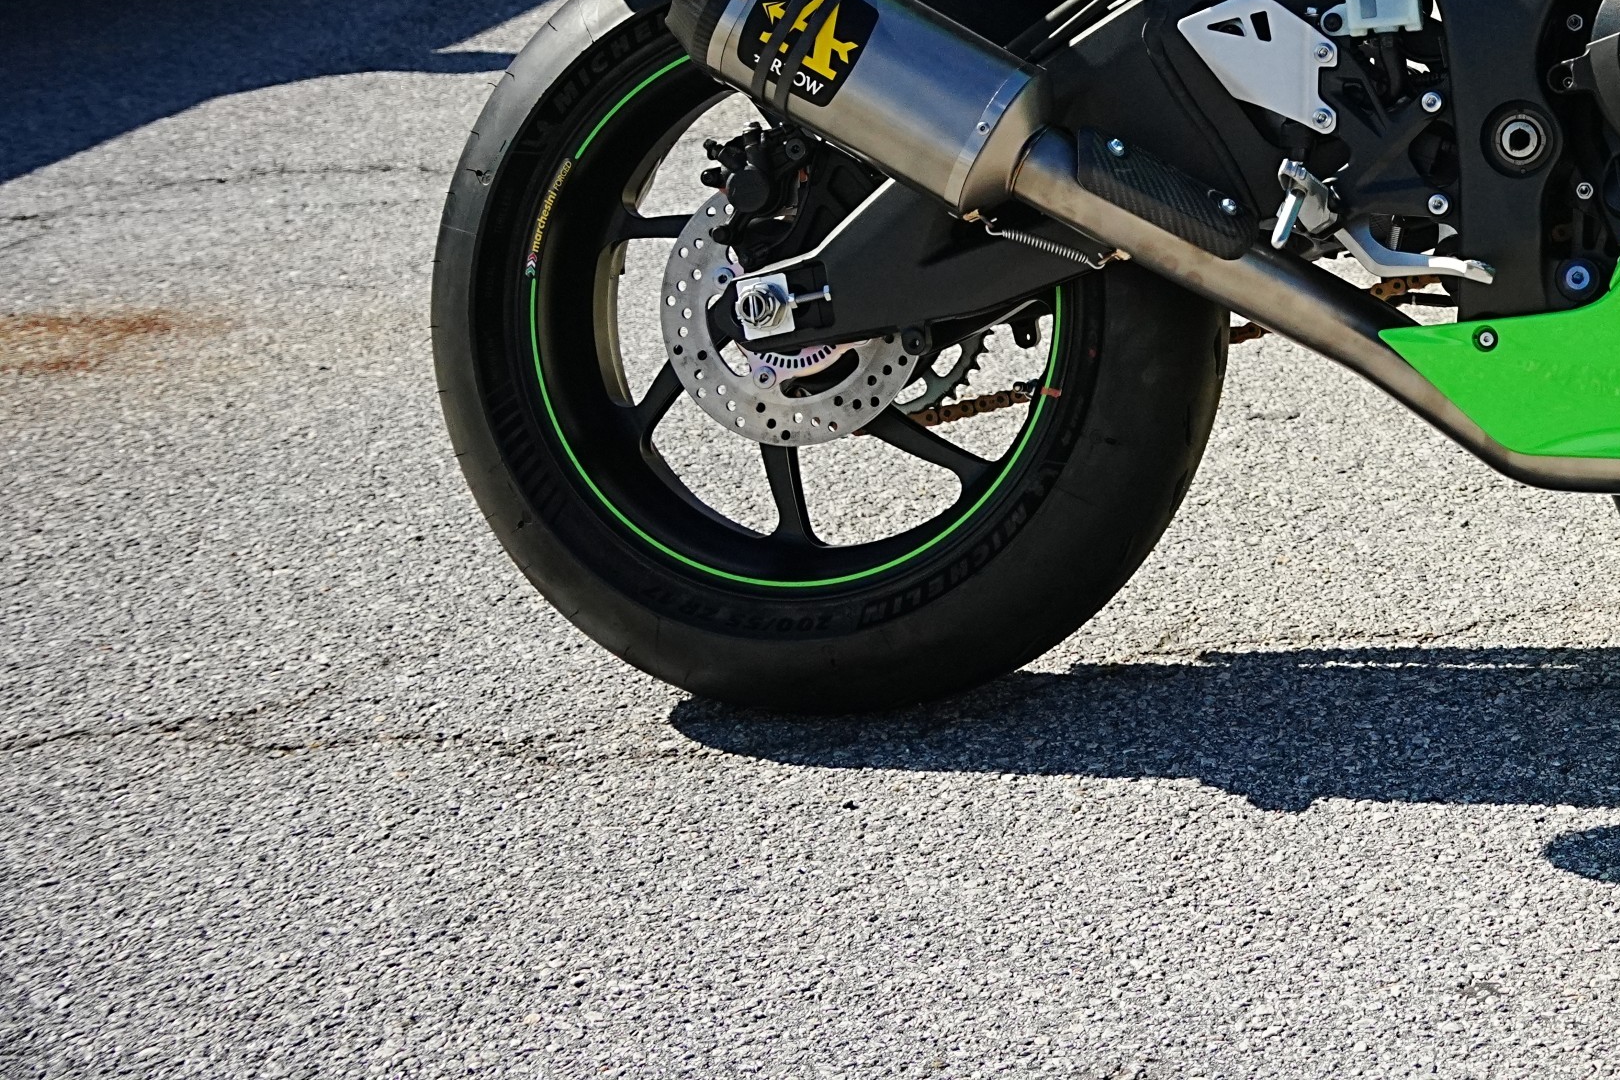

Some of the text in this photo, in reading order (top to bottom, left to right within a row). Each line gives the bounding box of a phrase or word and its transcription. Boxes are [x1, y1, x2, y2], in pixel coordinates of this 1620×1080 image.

[753, 53, 824, 96] ROW
[532, 161, 572, 253] marchesini FORGED
[861, 502, 1029, 623] MICHELIN
